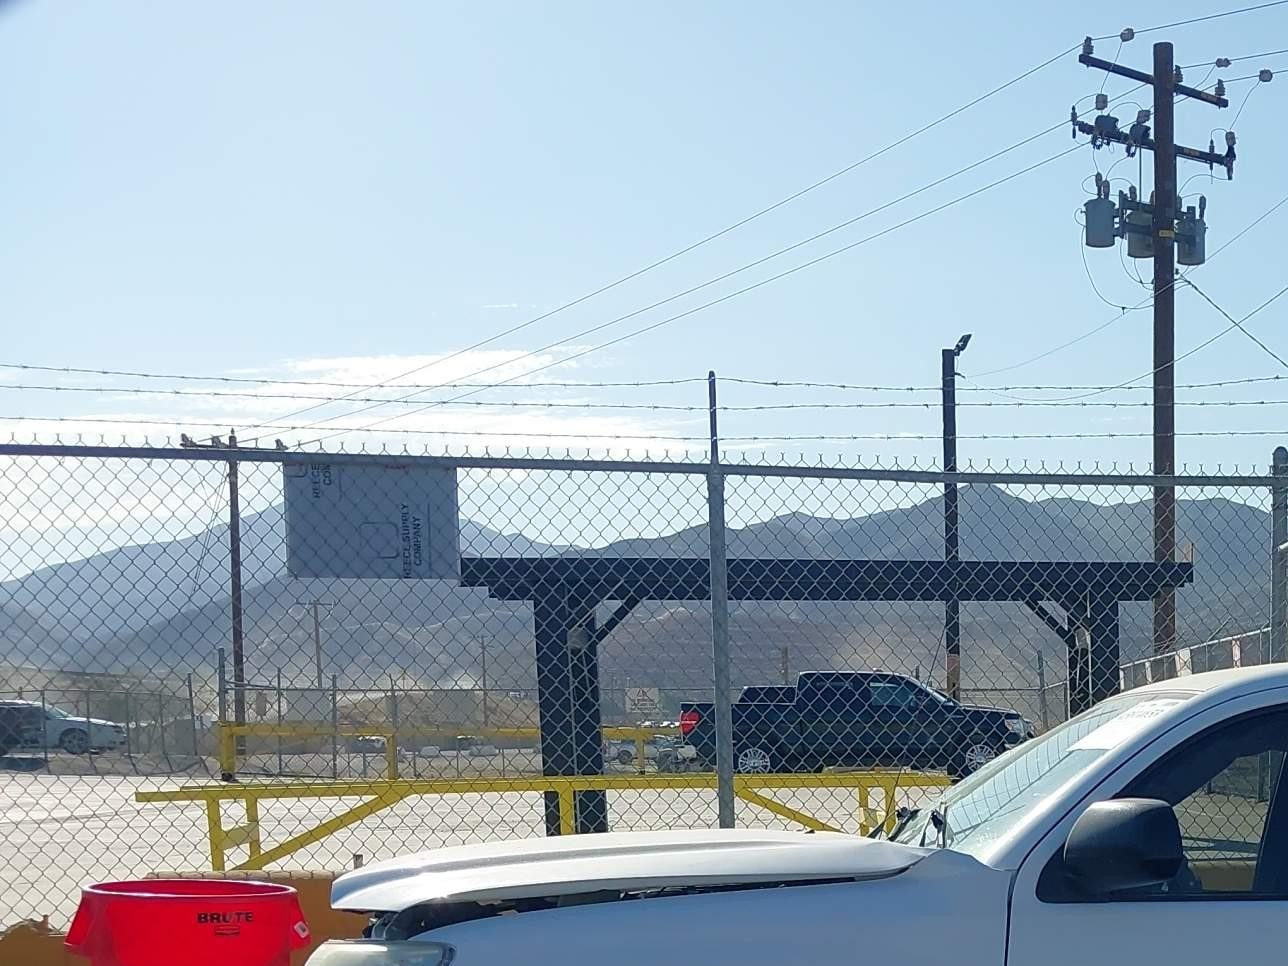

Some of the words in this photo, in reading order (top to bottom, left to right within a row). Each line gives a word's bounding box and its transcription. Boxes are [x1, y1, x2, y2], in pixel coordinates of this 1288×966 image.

[400, 503, 410, 543] SUPPLY
[412, 516, 422, 566] COMPANY
[197, 911, 254, 924] BRUTE
